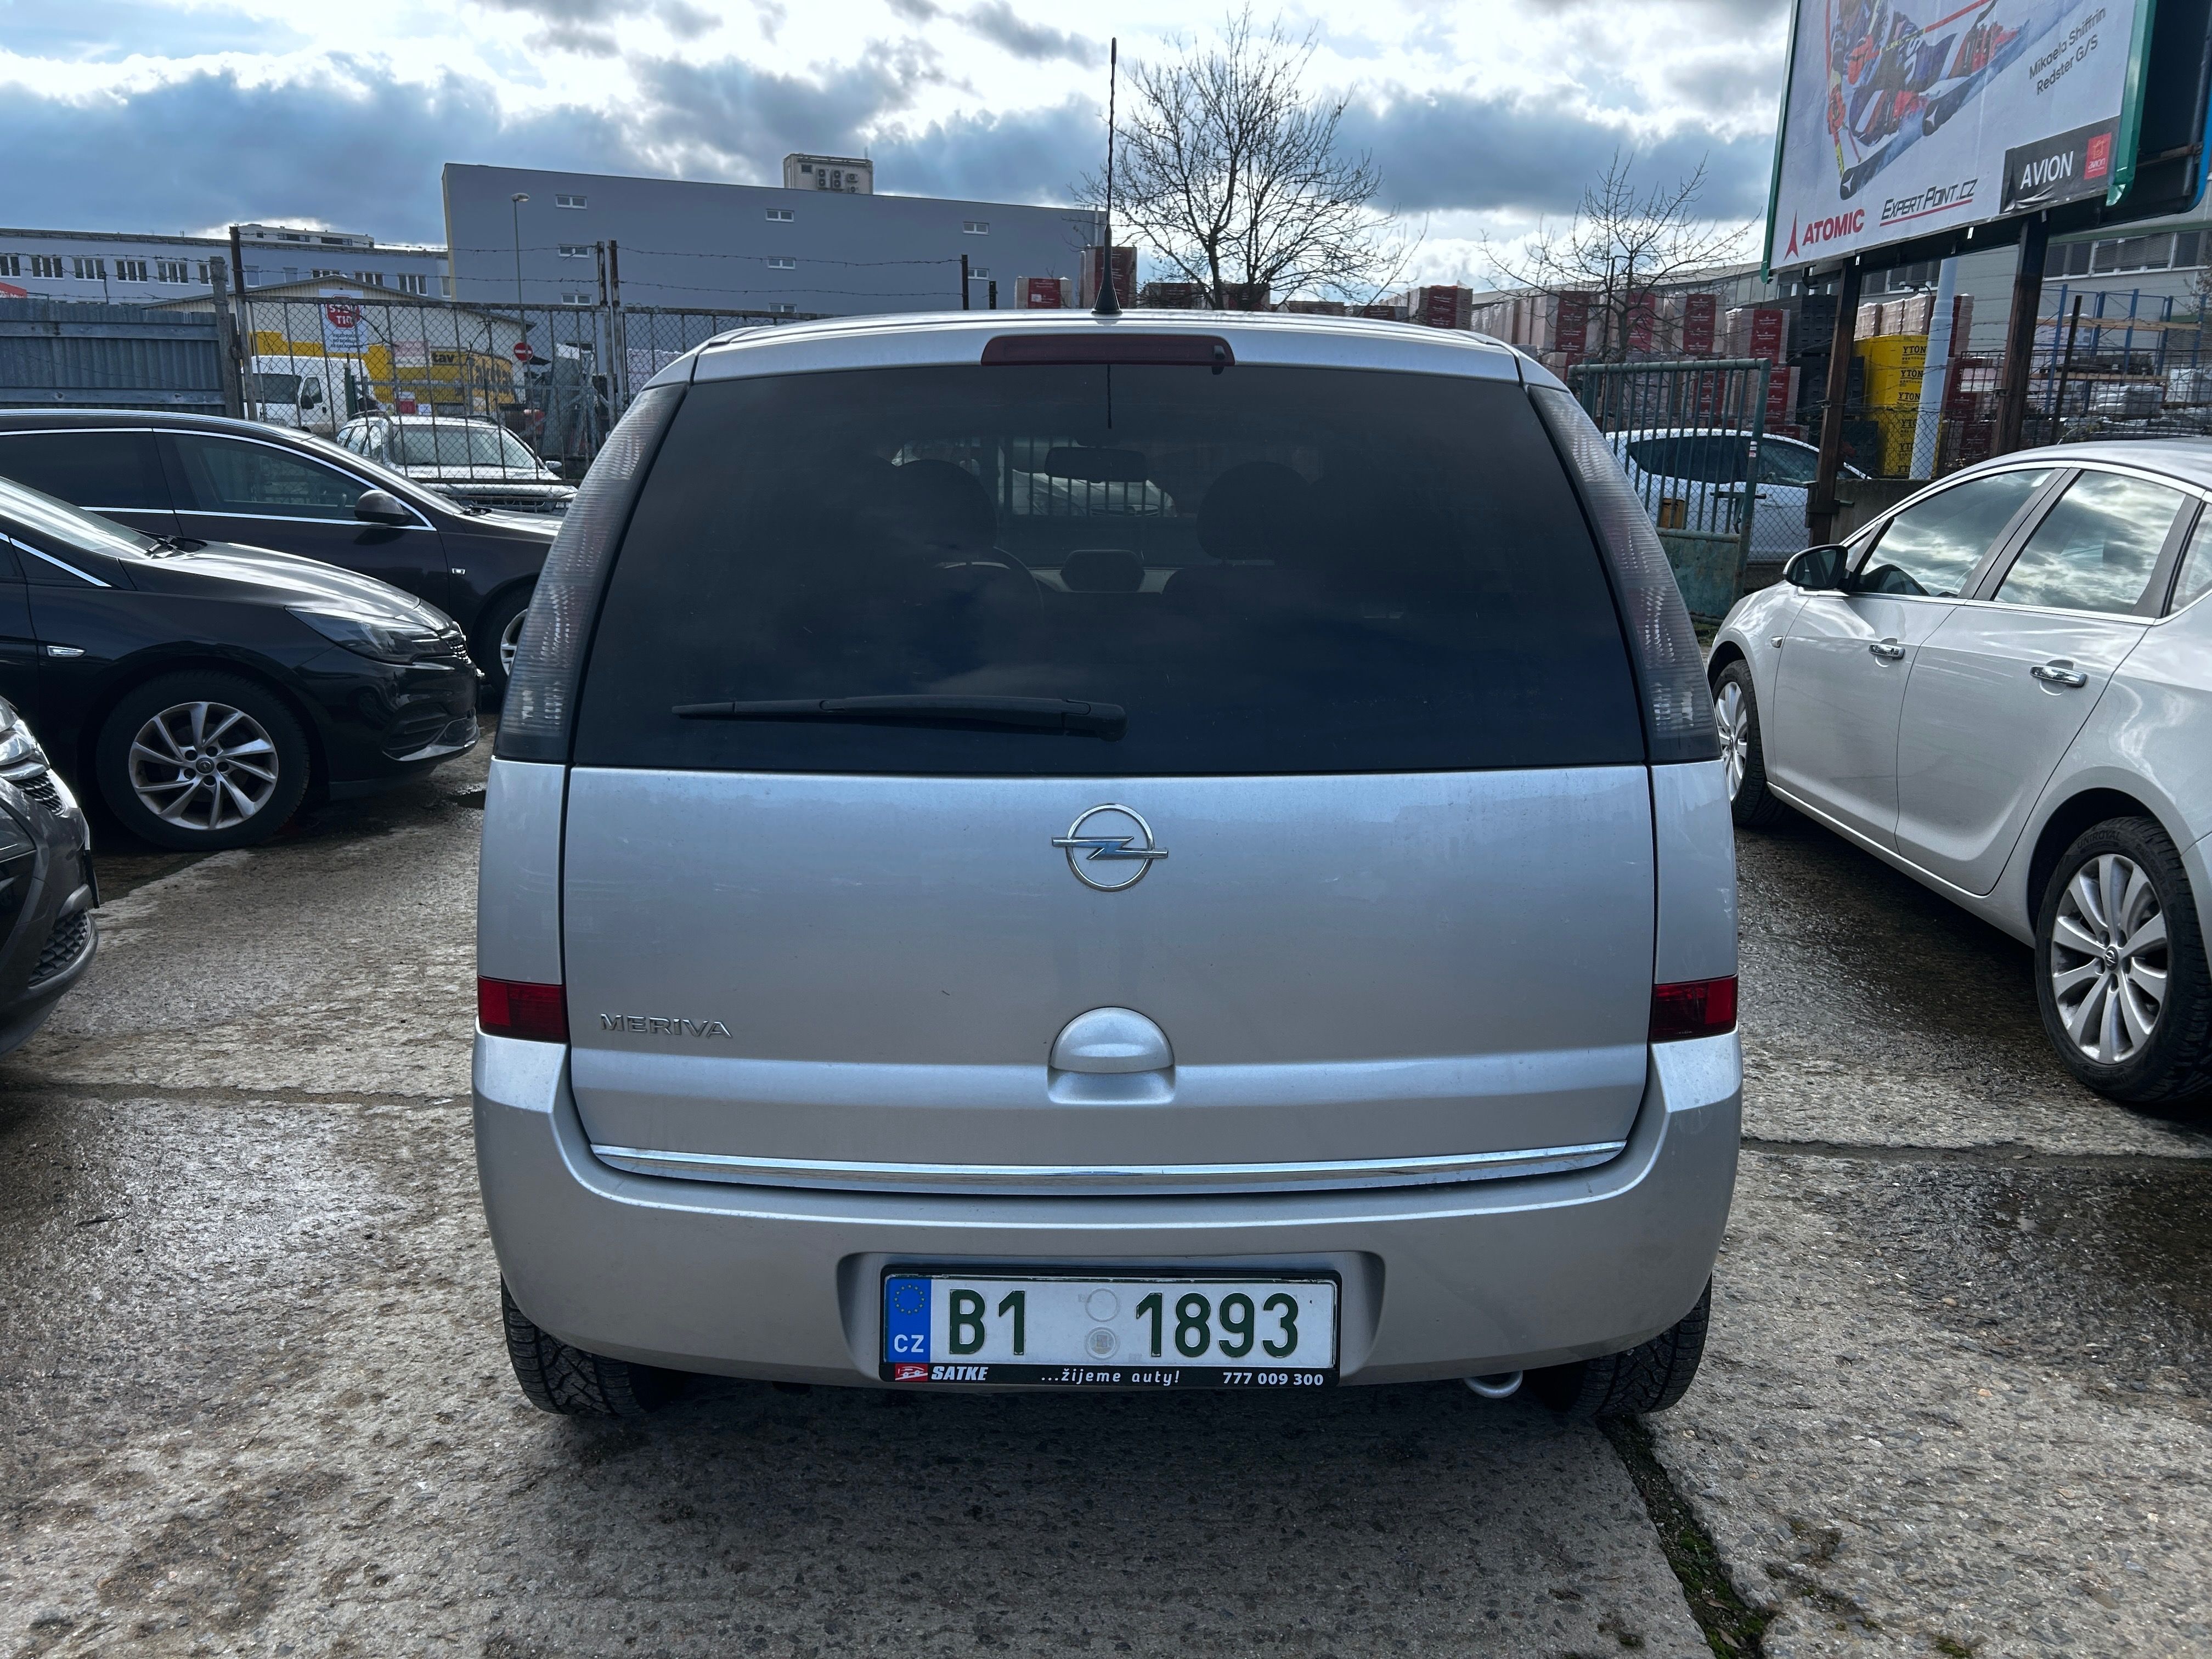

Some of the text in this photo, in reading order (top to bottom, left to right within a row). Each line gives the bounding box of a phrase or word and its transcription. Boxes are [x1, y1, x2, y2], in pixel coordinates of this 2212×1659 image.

[2029, 7, 2106, 80] Mikaela Shiffrin
[2036, 34, 2098, 95] Redster G/S
[2020, 150, 2074, 190] AVION
[1802, 208, 1865, 246] ATOMIC
[2077, 830, 2121, 849] UNIROYAL
[600, 1013, 733, 1040] MERIVA
[949, 1289, 1299, 1358] B1 1893
[894, 1334, 924, 1353] CZ
[931, 1366, 989, 1381] SATKE
[1131, 1370, 1180, 1386] auty!
[1223, 1372, 1324, 1386] 777 009 300
